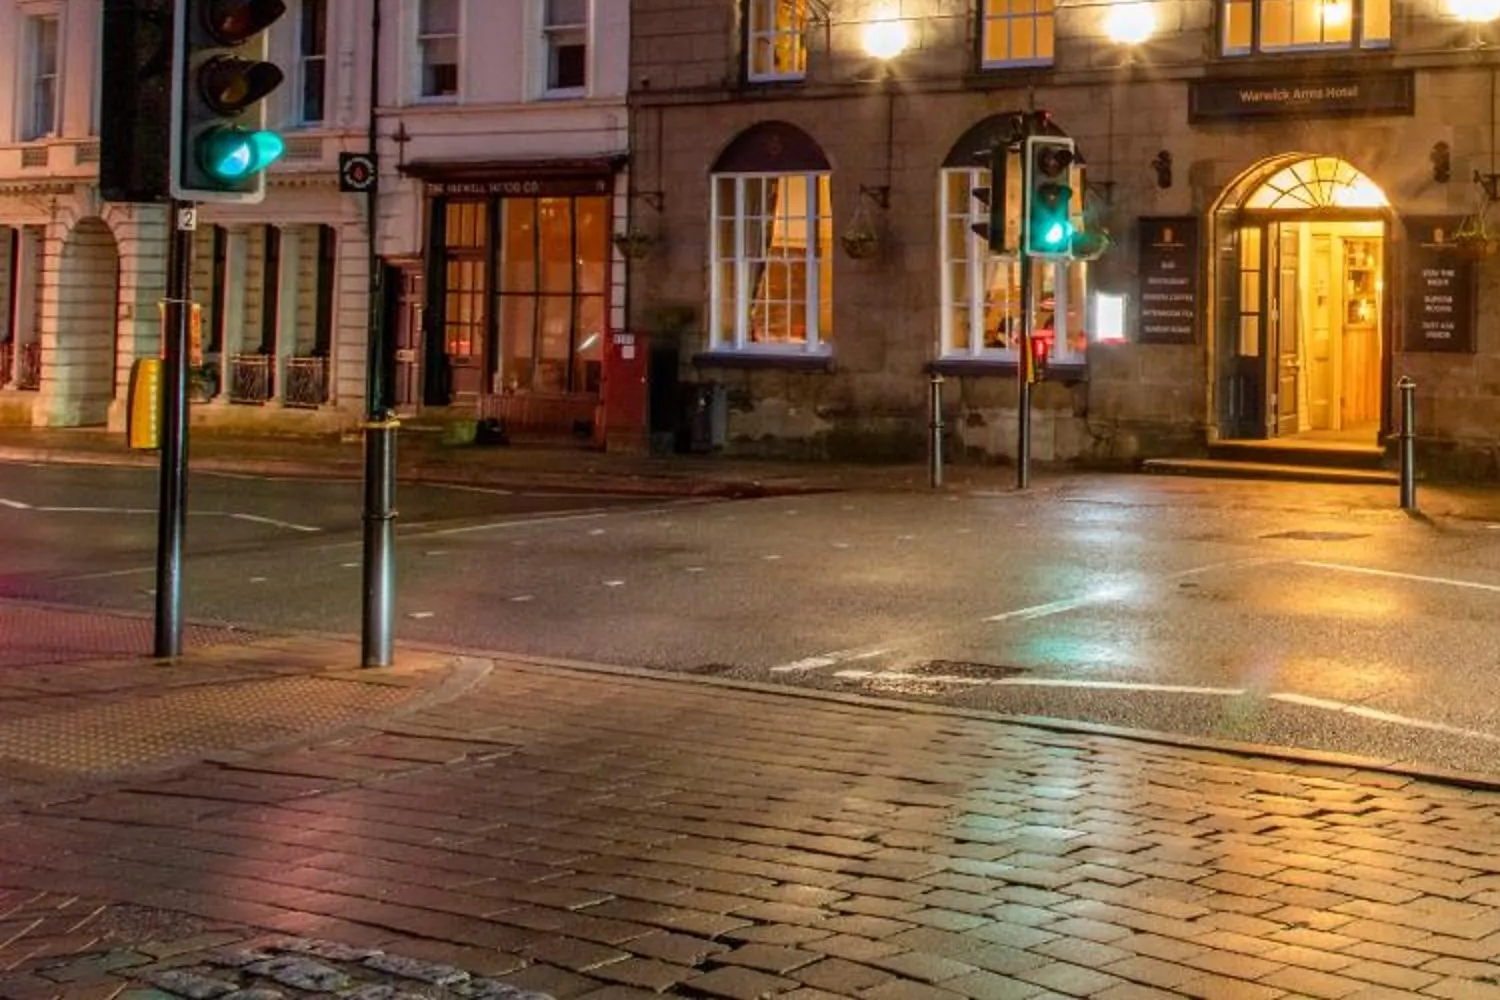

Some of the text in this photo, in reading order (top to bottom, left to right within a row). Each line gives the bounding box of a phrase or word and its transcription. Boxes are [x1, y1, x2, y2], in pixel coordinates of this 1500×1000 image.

[1238, 85, 1359, 102] Warwick Arms Hotel
[184, 211, 193, 227] 2
